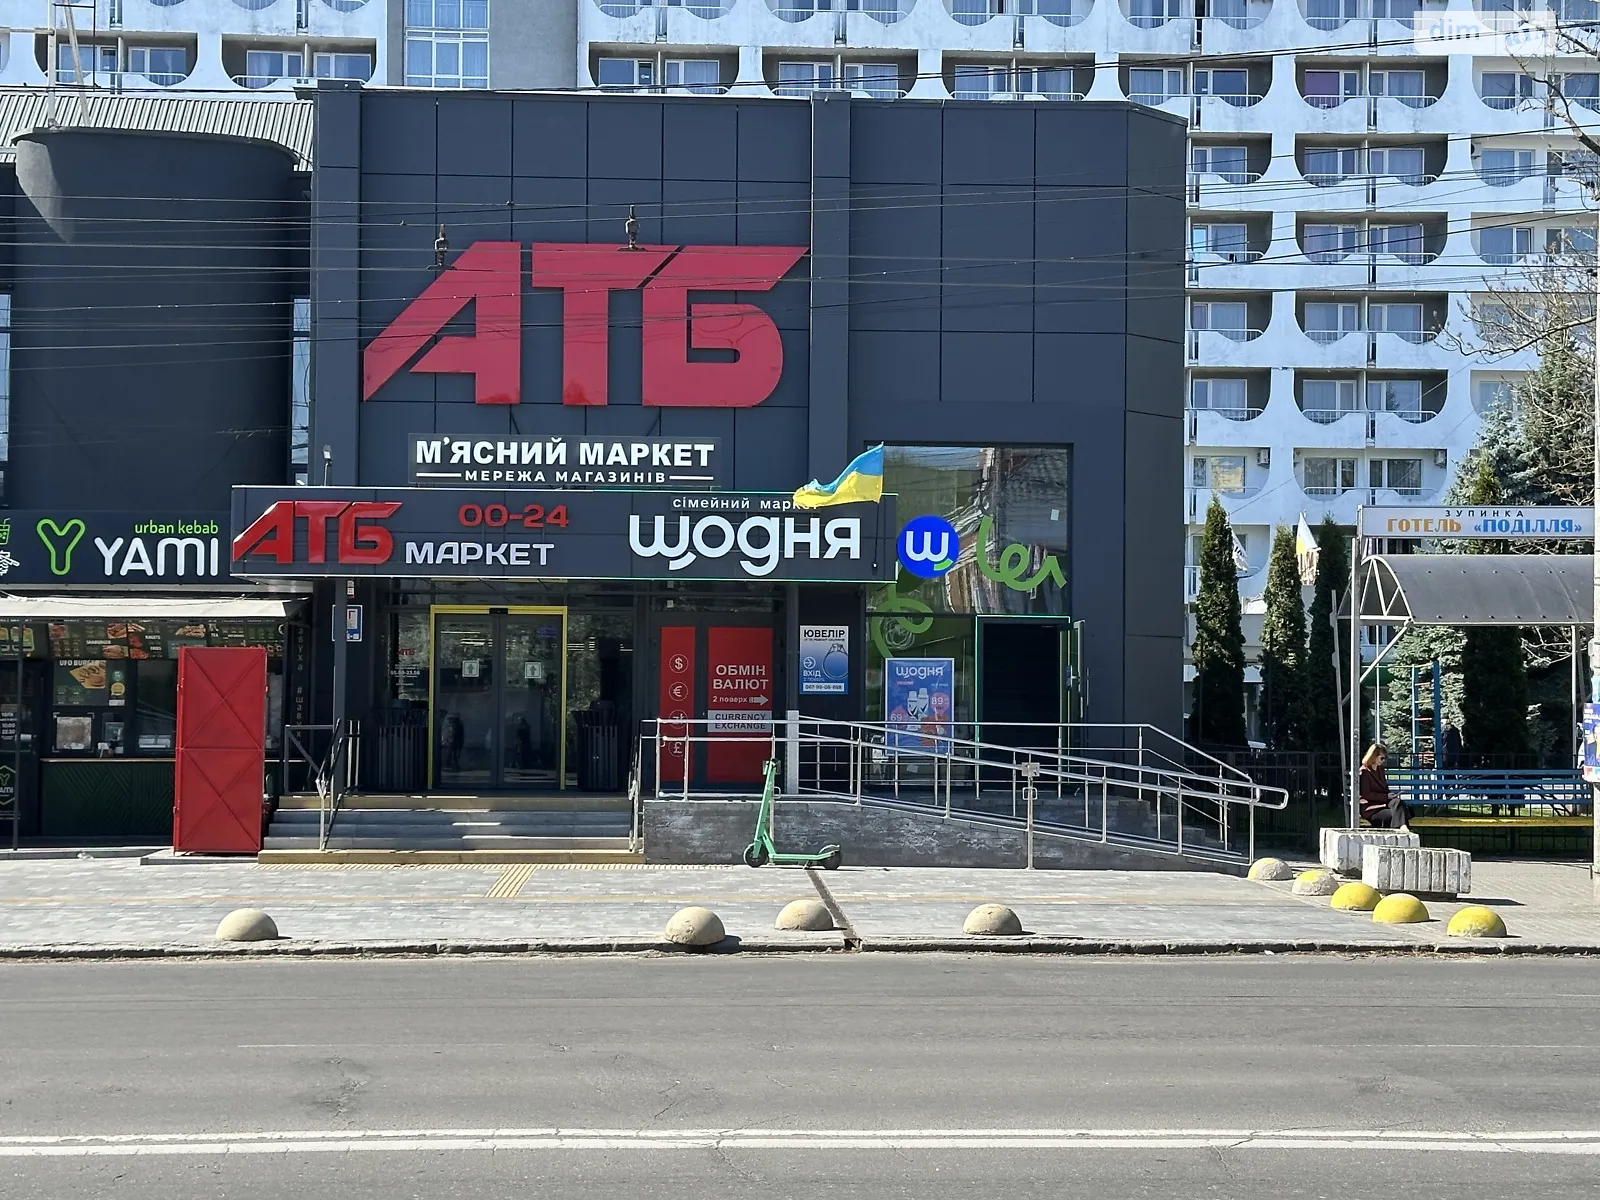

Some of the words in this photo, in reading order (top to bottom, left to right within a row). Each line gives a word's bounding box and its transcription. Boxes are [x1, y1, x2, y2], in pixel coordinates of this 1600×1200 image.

[363, 241, 809, 407] АТБ
[579, 442, 715, 467] МАРКЕТ
[465, 470, 546, 482] МЕРЕЖА
[555, 471, 665, 483] МАГАЗИНІВ
[672, 496, 750, 509] сімейний
[458, 504, 569, 528] 00-24
[1445, 509, 1524, 518] ЗУПИНКА
[135, 519, 174, 534] urban
[178, 519, 219, 534] kebab
[232, 501, 402, 565] АТБ
[1387, 519, 1462, 533] ГОТЕЛЬ
[1474, 518, 1582, 535] «ПОДІЛЛЯ»
[94, 537, 219, 576] YAMI
[405, 541, 555, 566] МАРКЕТ
[803, 629, 845, 638] ЮВЕЛІР
[715, 664, 766, 676] ОБМІН
[803, 670, 821, 678] ВХІД
[712, 679, 769, 690] ВАЛЮТ
[712, 695, 718, 703] 2
[715, 713, 766, 721] CURRENCY
[715, 722, 766, 730] EXCHANGE
